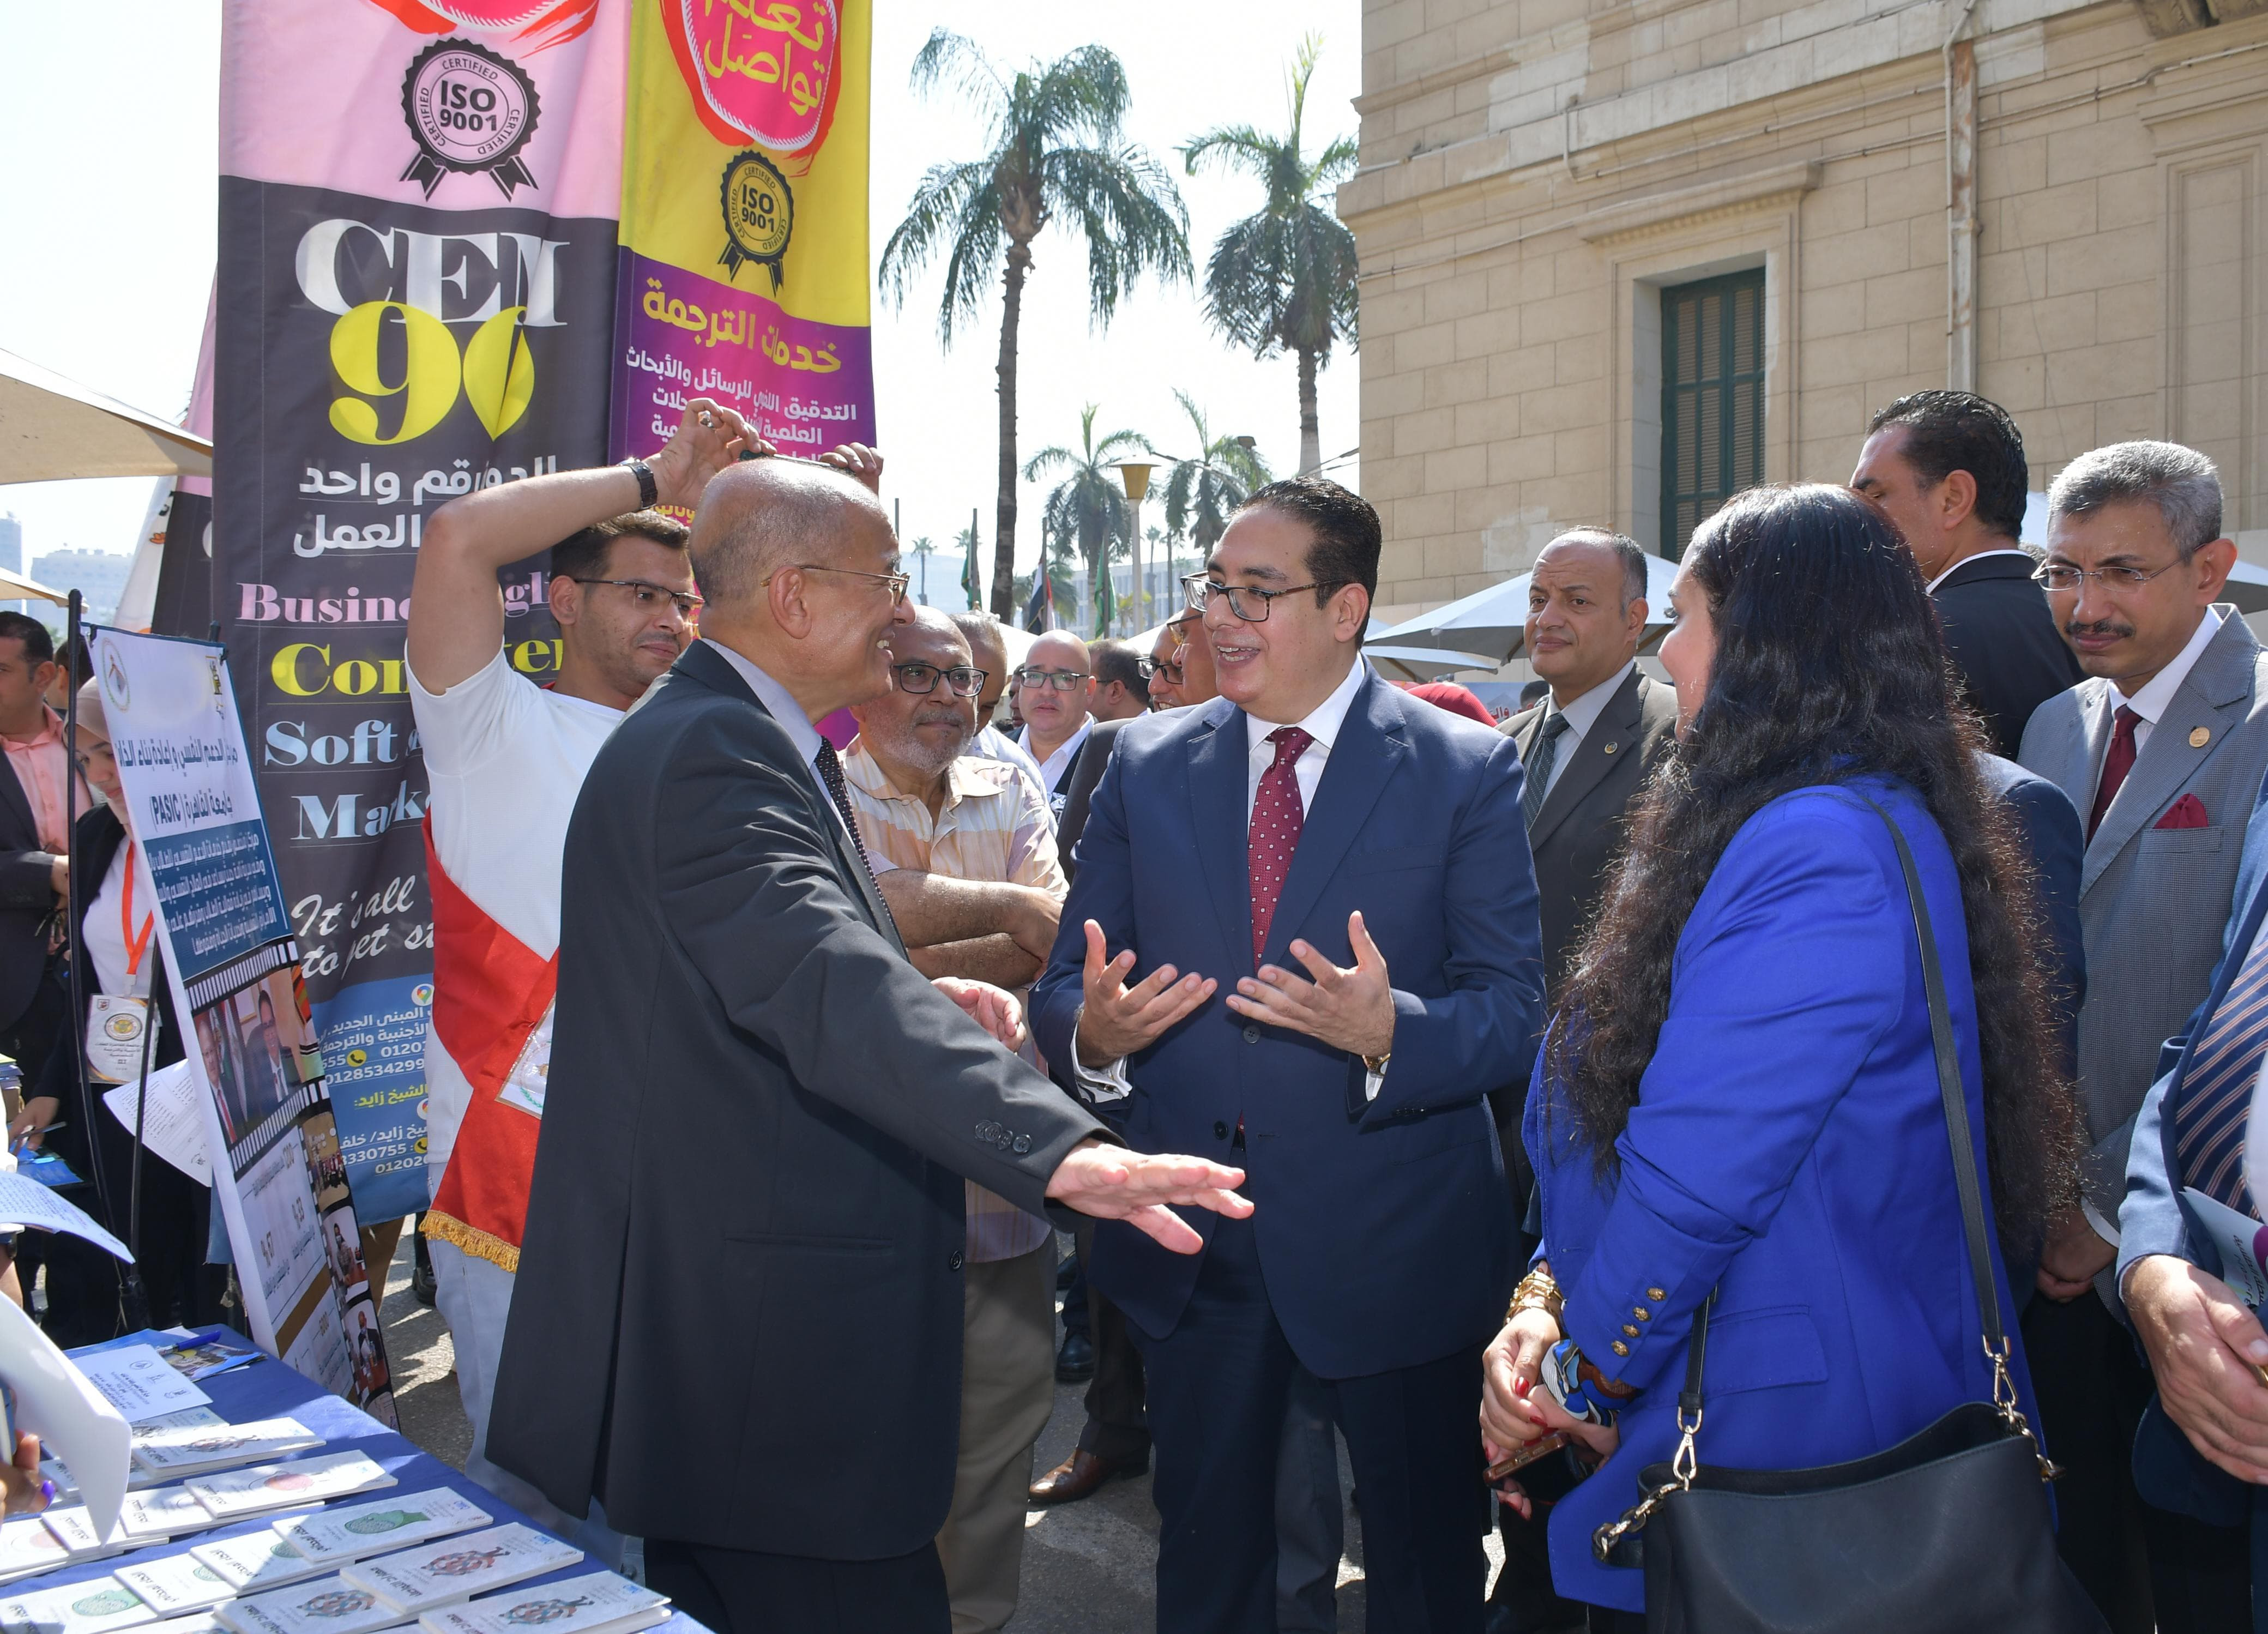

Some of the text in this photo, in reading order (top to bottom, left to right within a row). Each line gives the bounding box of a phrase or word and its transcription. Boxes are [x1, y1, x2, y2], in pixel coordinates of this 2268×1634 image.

[442, 57, 498, 81] CERTIFIED
[704, 13, 825, 116] تواصل
[440, 80, 496, 112] ISO
[419, 87, 447, 147] CERTIFIED
[440, 111, 497, 132] 9001
[476, 108, 521, 155] CERTIFIED
[744, 167, 776, 189] CERTIFIED
[732, 189, 746, 238] CERTIFIED
[742, 184, 774, 215] ISO
[741, 208, 775, 233] 9001
[762, 219, 787, 250] CERTIFIED
[642, 276, 842, 373] خدمات الترجمة
[626, 346, 692, 387] والأبحاث
[693, 368, 752, 401] للرسائل
[784, 397, 857, 422] التدقيق
[763, 419, 823, 445] العلمية
[299, 462, 401, 505] واحد
[293, 513, 421, 558] العمل
[178, 737, 204, 776] النفسي
[264, 719, 399, 766] Soft
[184, 791, 211, 824] القاهرة
[209, 789, 233, 816] جامعة
[364, 875, 416, 918] all
[301, 945, 339, 979] to
[377, 1006, 424, 1027] المبنى
[322, 1033, 375, 1054] والترجمة
